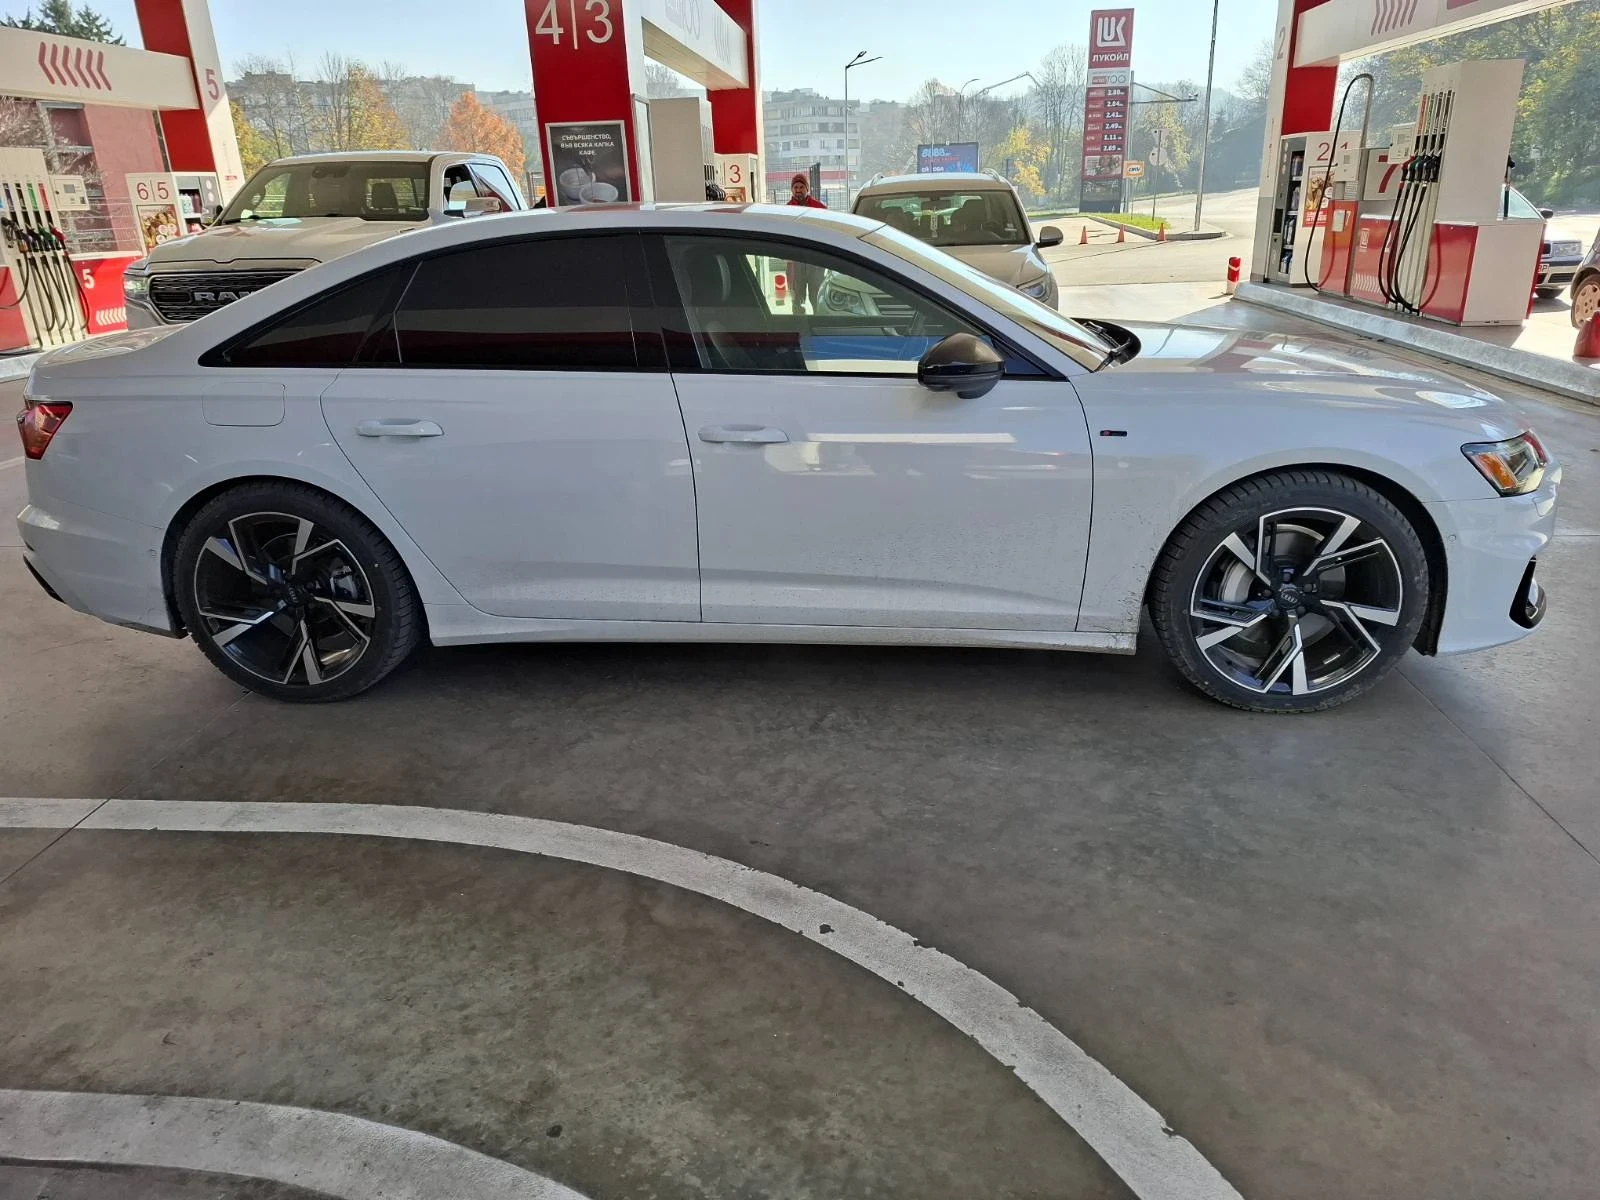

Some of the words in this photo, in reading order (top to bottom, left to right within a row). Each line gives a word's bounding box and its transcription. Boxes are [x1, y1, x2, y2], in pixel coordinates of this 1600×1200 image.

[535, 0, 564, 45] 4
[585, 0, 613, 43] 3
[1276, 27, 1286, 60] 2
[1092, 52, 1129, 62] ЛУКОЙЛ
[206, 69, 220, 101] 5
[1317, 142, 1330, 161] 2
[729, 164, 741, 184] 3
[136, 182, 149, 201] 6
[156, 181, 169, 200] 5
[82, 268, 95, 289] 5
